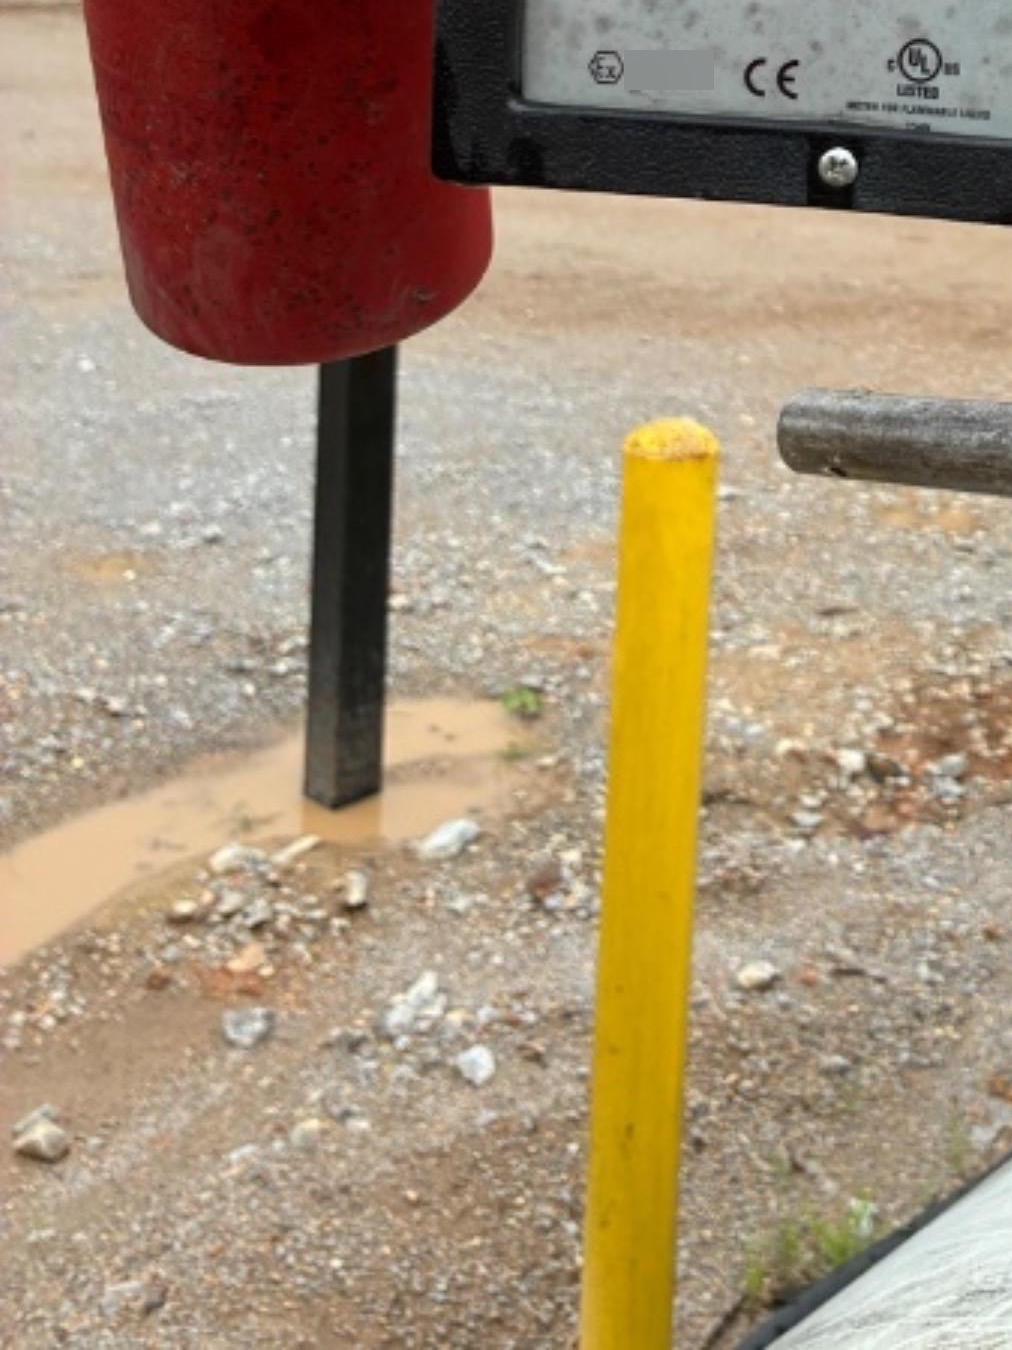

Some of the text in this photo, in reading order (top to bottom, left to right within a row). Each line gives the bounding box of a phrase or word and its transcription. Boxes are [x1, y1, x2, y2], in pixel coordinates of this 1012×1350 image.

[908, 48, 930, 75] UL
[743, 58, 799, 99] CE
[896, 83, 940, 100] LISTED
